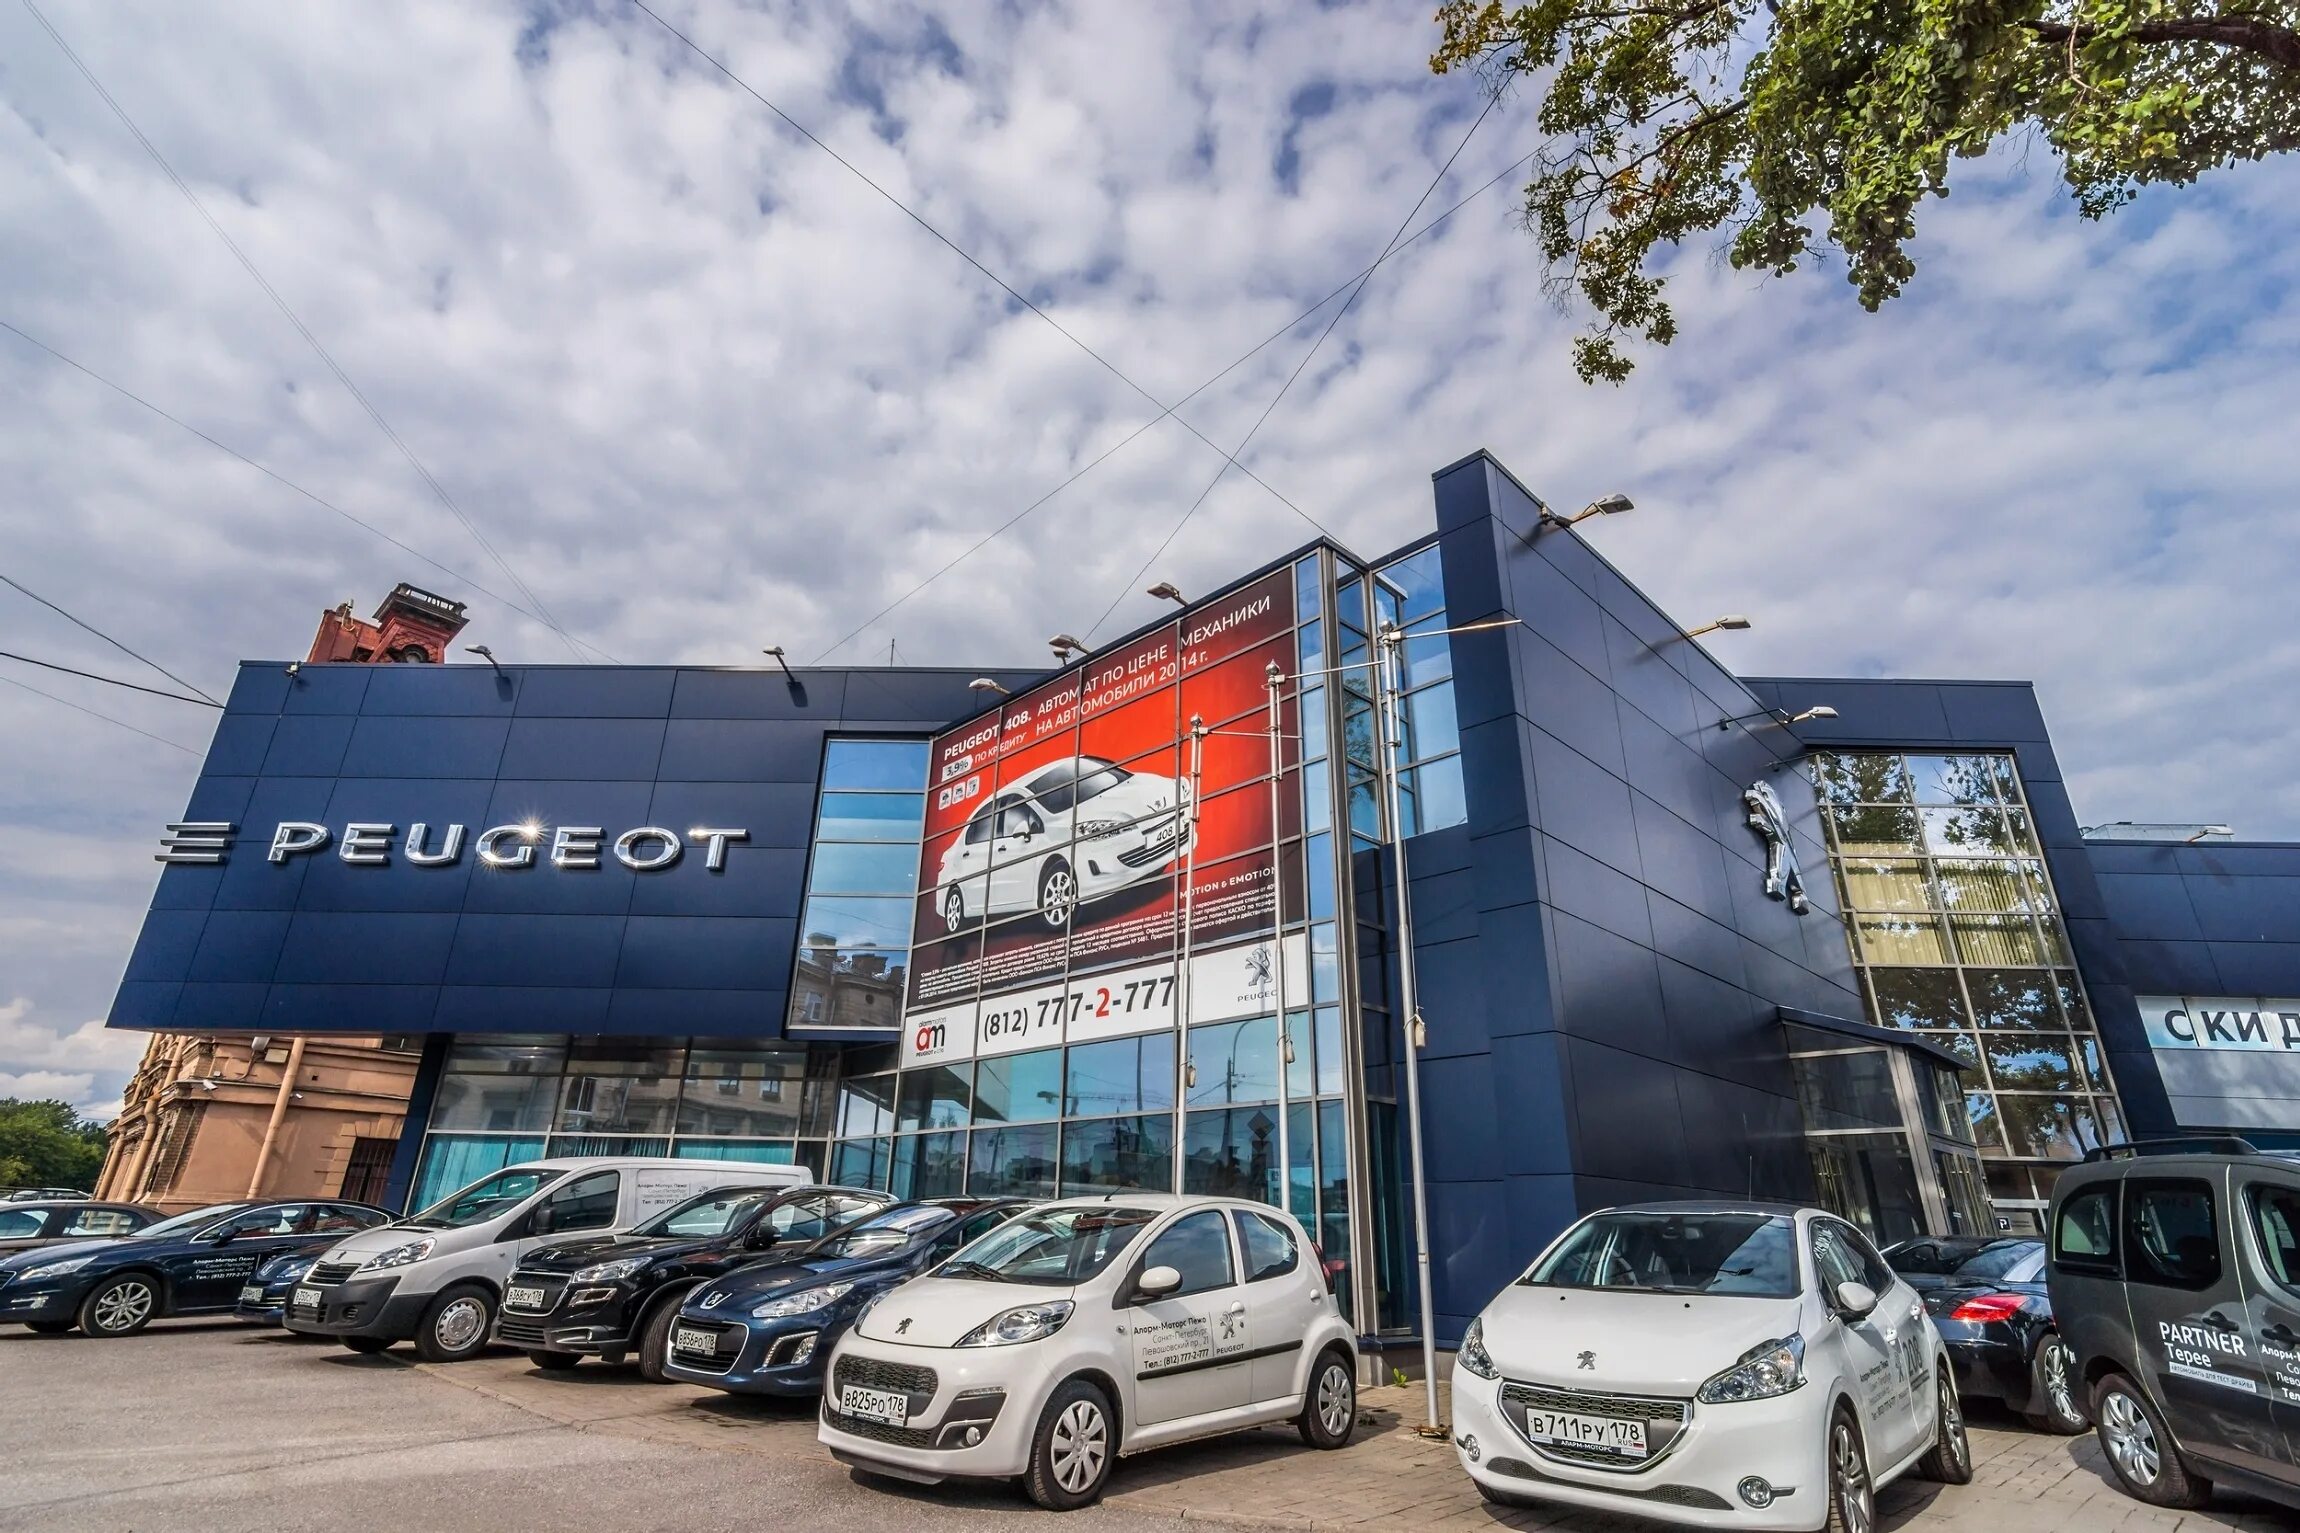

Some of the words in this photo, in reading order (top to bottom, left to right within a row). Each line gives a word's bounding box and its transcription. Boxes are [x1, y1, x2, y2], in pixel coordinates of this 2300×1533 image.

[944, 724, 1000, 761] PEUGEOT
[1004, 711, 1032, 731] 408.
[1037, 676, 1099, 716] АВТОМАТ
[1102, 666, 1123, 687] ПО
[1128, 645, 1168, 674] ЦЕНЕ
[1181, 595, 1270, 650] МЕХАНИКИ
[974, 751, 986, 764] ПО
[1036, 721, 1053, 736] НА
[1055, 673, 1155, 728] АВТОМОБИЛИ
[1159, 654, 1197, 681] 2014
[1200, 650, 1208, 663] г.
[267, 821, 748, 872] PEUGEOT
[1238, 990, 1277, 1002] PEUGEO
[984, 1007, 1028, 1043] (812)
[1037, 975, 1174, 1029] 777-2-777
[1188, 1317, 1207, 1327] Пежо
[704, 1335, 715, 1346] 178
[1216, 1343, 1245, 1355] PEUGEOT
[2160, 1321, 2247, 1357] PARTNER
[1163, 1355, 1180, 1368] (812)
[1180, 1349, 1209, 1362] 777-2-777
[1902, 1335, 1922, 1377] 208
[2164, 1341, 2212, 1368] Tepee
[887, 1395, 905, 1412] 178
[1610, 1421, 1640, 1441] 178
[1617, 1438, 1633, 1447] RUS
